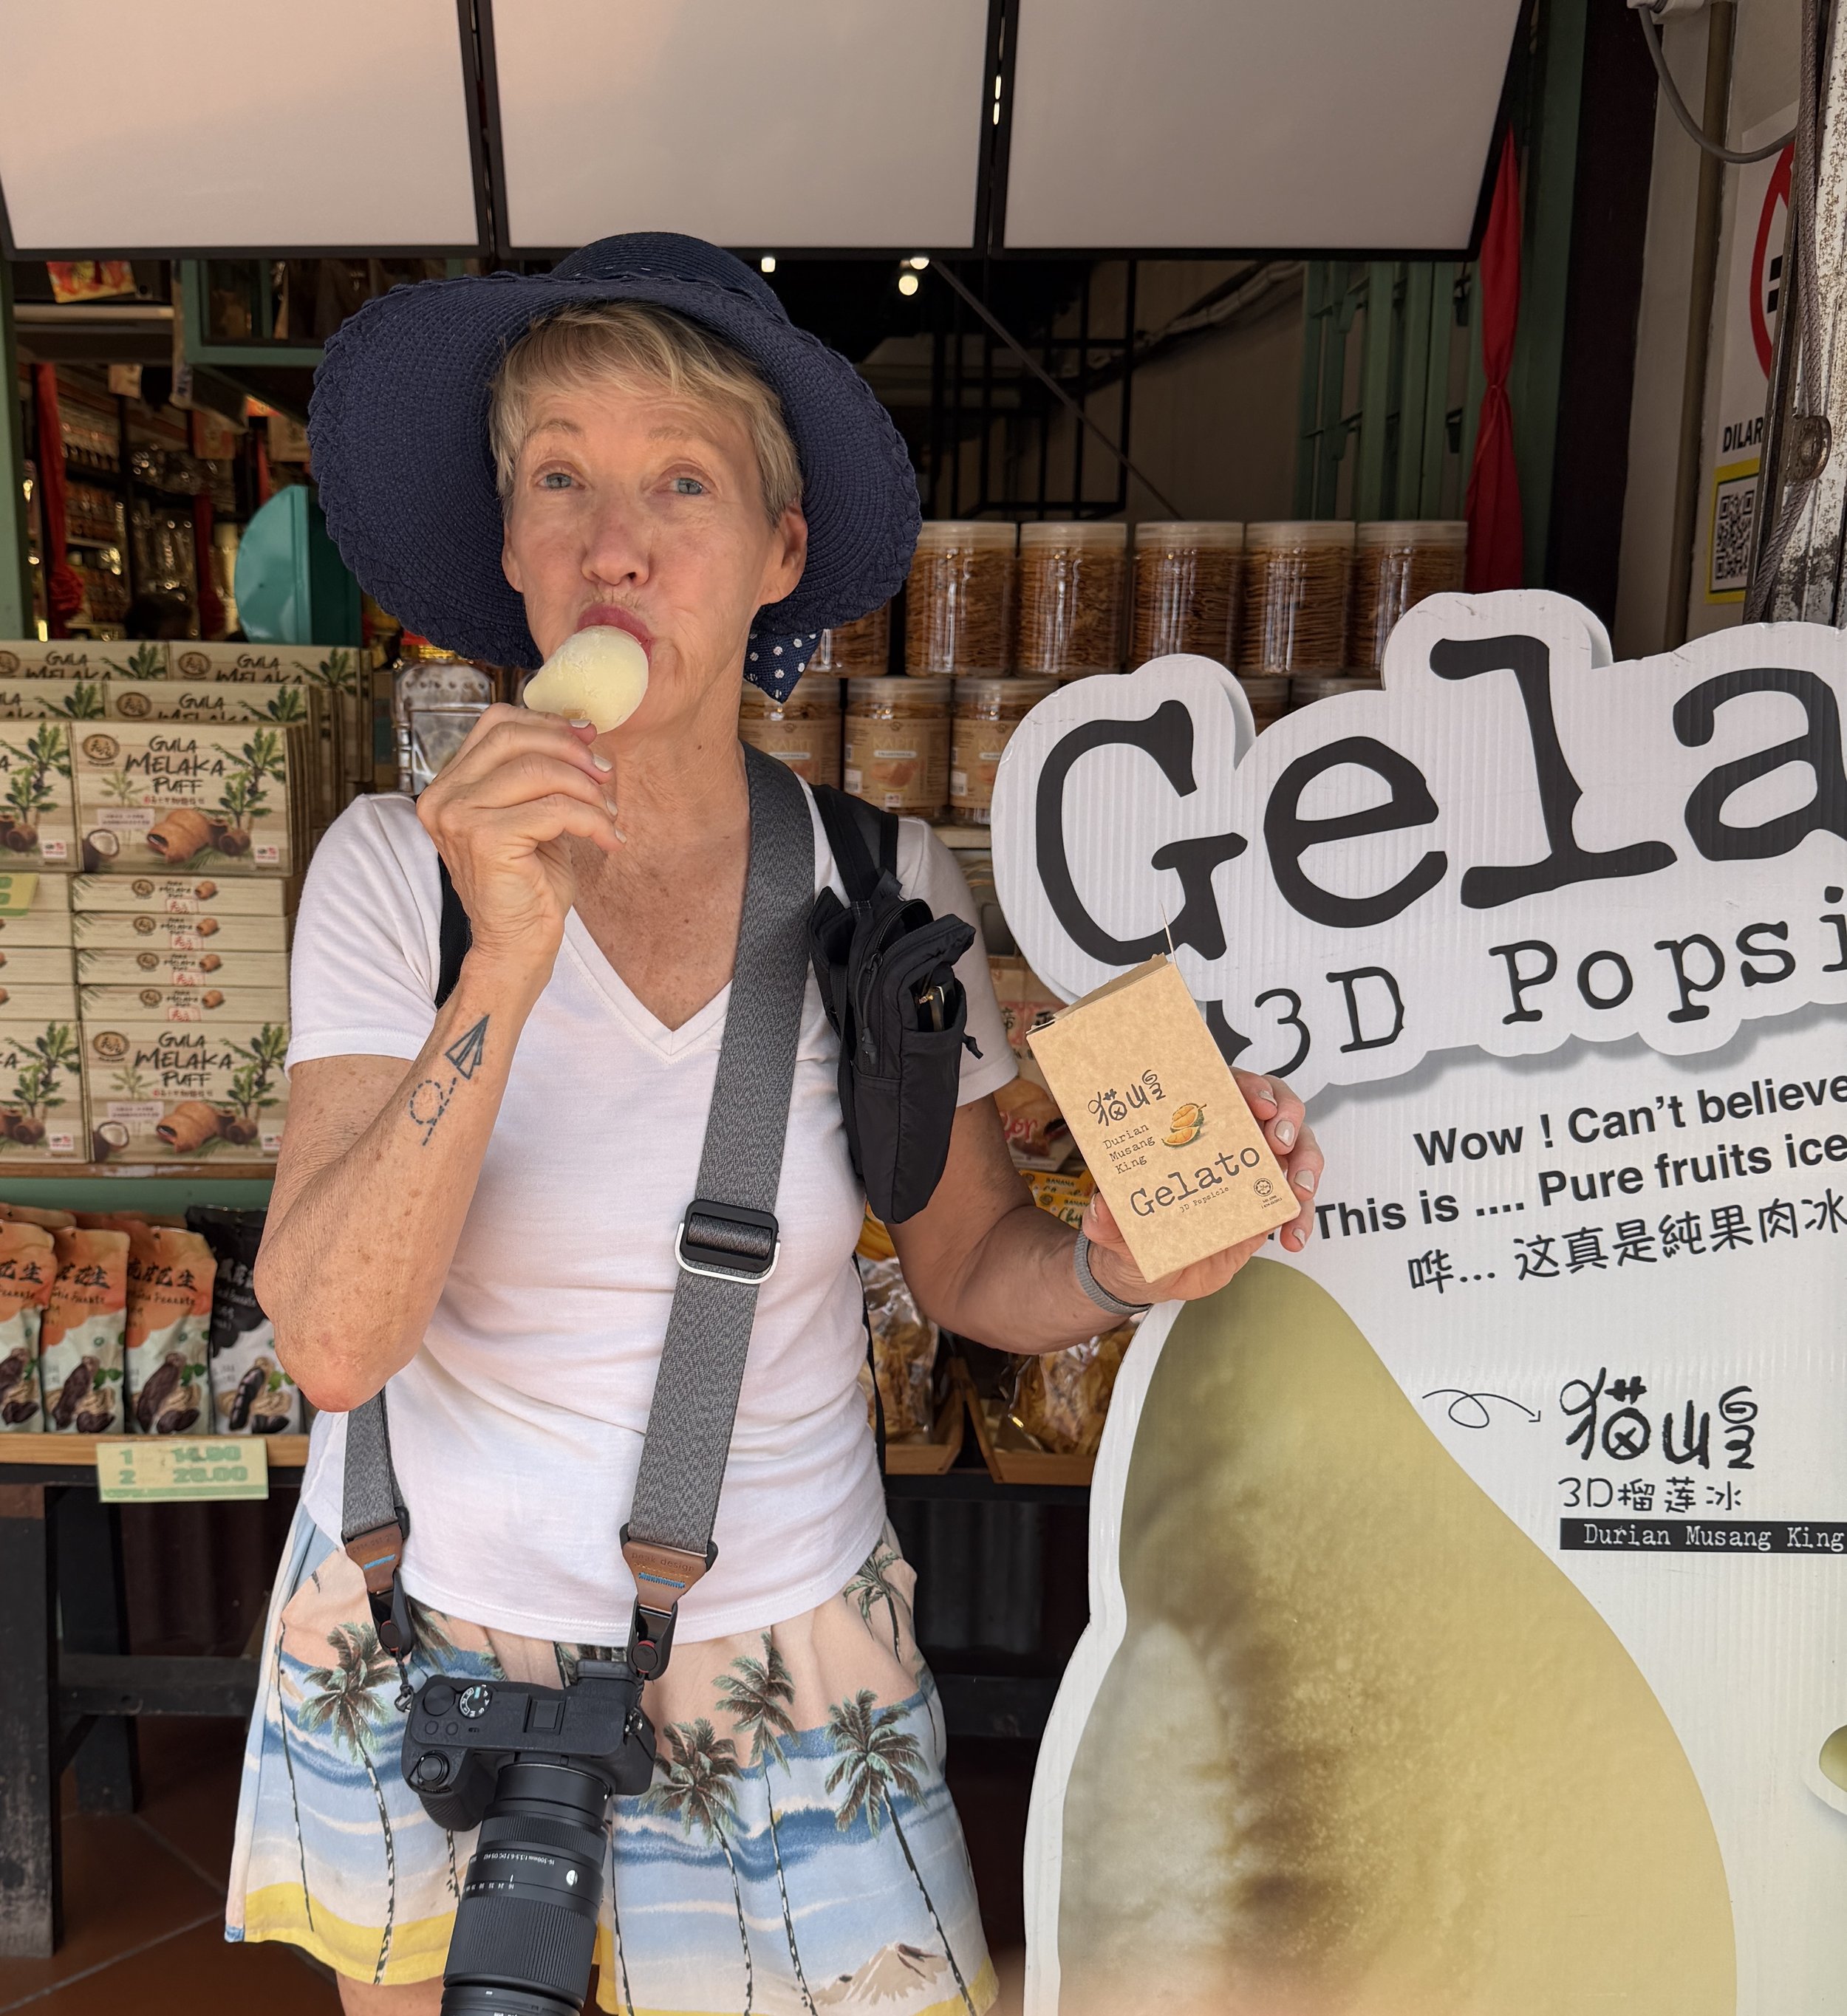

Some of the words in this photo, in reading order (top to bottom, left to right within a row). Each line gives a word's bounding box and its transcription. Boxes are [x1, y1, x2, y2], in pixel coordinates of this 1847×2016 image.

[46, 649, 87, 666] GULA
[237, 654, 280, 669] GULA
[178, 694, 225, 709] GULA
[149, 735, 197, 753] GULA
[124, 752, 227, 776] MELAKA
[152, 777, 204, 795] PUFF
[1036, 635, 1847, 966] Gela
[1254, 966, 1404, 1078] 3D
[1488, 886, 1847, 1025] Popsi
[158, 1031, 205, 1049] GULA
[134, 1048, 236, 1070] MELAKA
[162, 1072, 212, 1087] PUFF
[1413, 1127, 1523, 1166] Wow
[1540, 1114, 1554, 1149] !
[1568, 1096, 1687, 1144] Can’t
[1697, 1075, 1847, 1124] believe
[1102, 1124, 1150, 1150] Durian
[1109, 1135, 1156, 1163] Musang
[1114, 1155, 1148, 1175] King
[1130, 1147, 1260, 1217] Gelato
[1315, 1197, 1407, 1240] This
[1418, 1190, 1459, 1225] is
[1538, 1166, 1644, 1207] Pure
[1653, 1144, 1772, 1189] fruits
[1784, 1133, 1847, 1169] ice
[1192, 1186, 1230, 1207] Popsicle
[119, 1469, 136, 1485] 2
[1583, 1523, 1670, 1546] Durian
[1685, 1525, 1772, 1551] Musang
[1786, 1525, 1845, 1553] King
[660, 1556, 695, 1572] design
